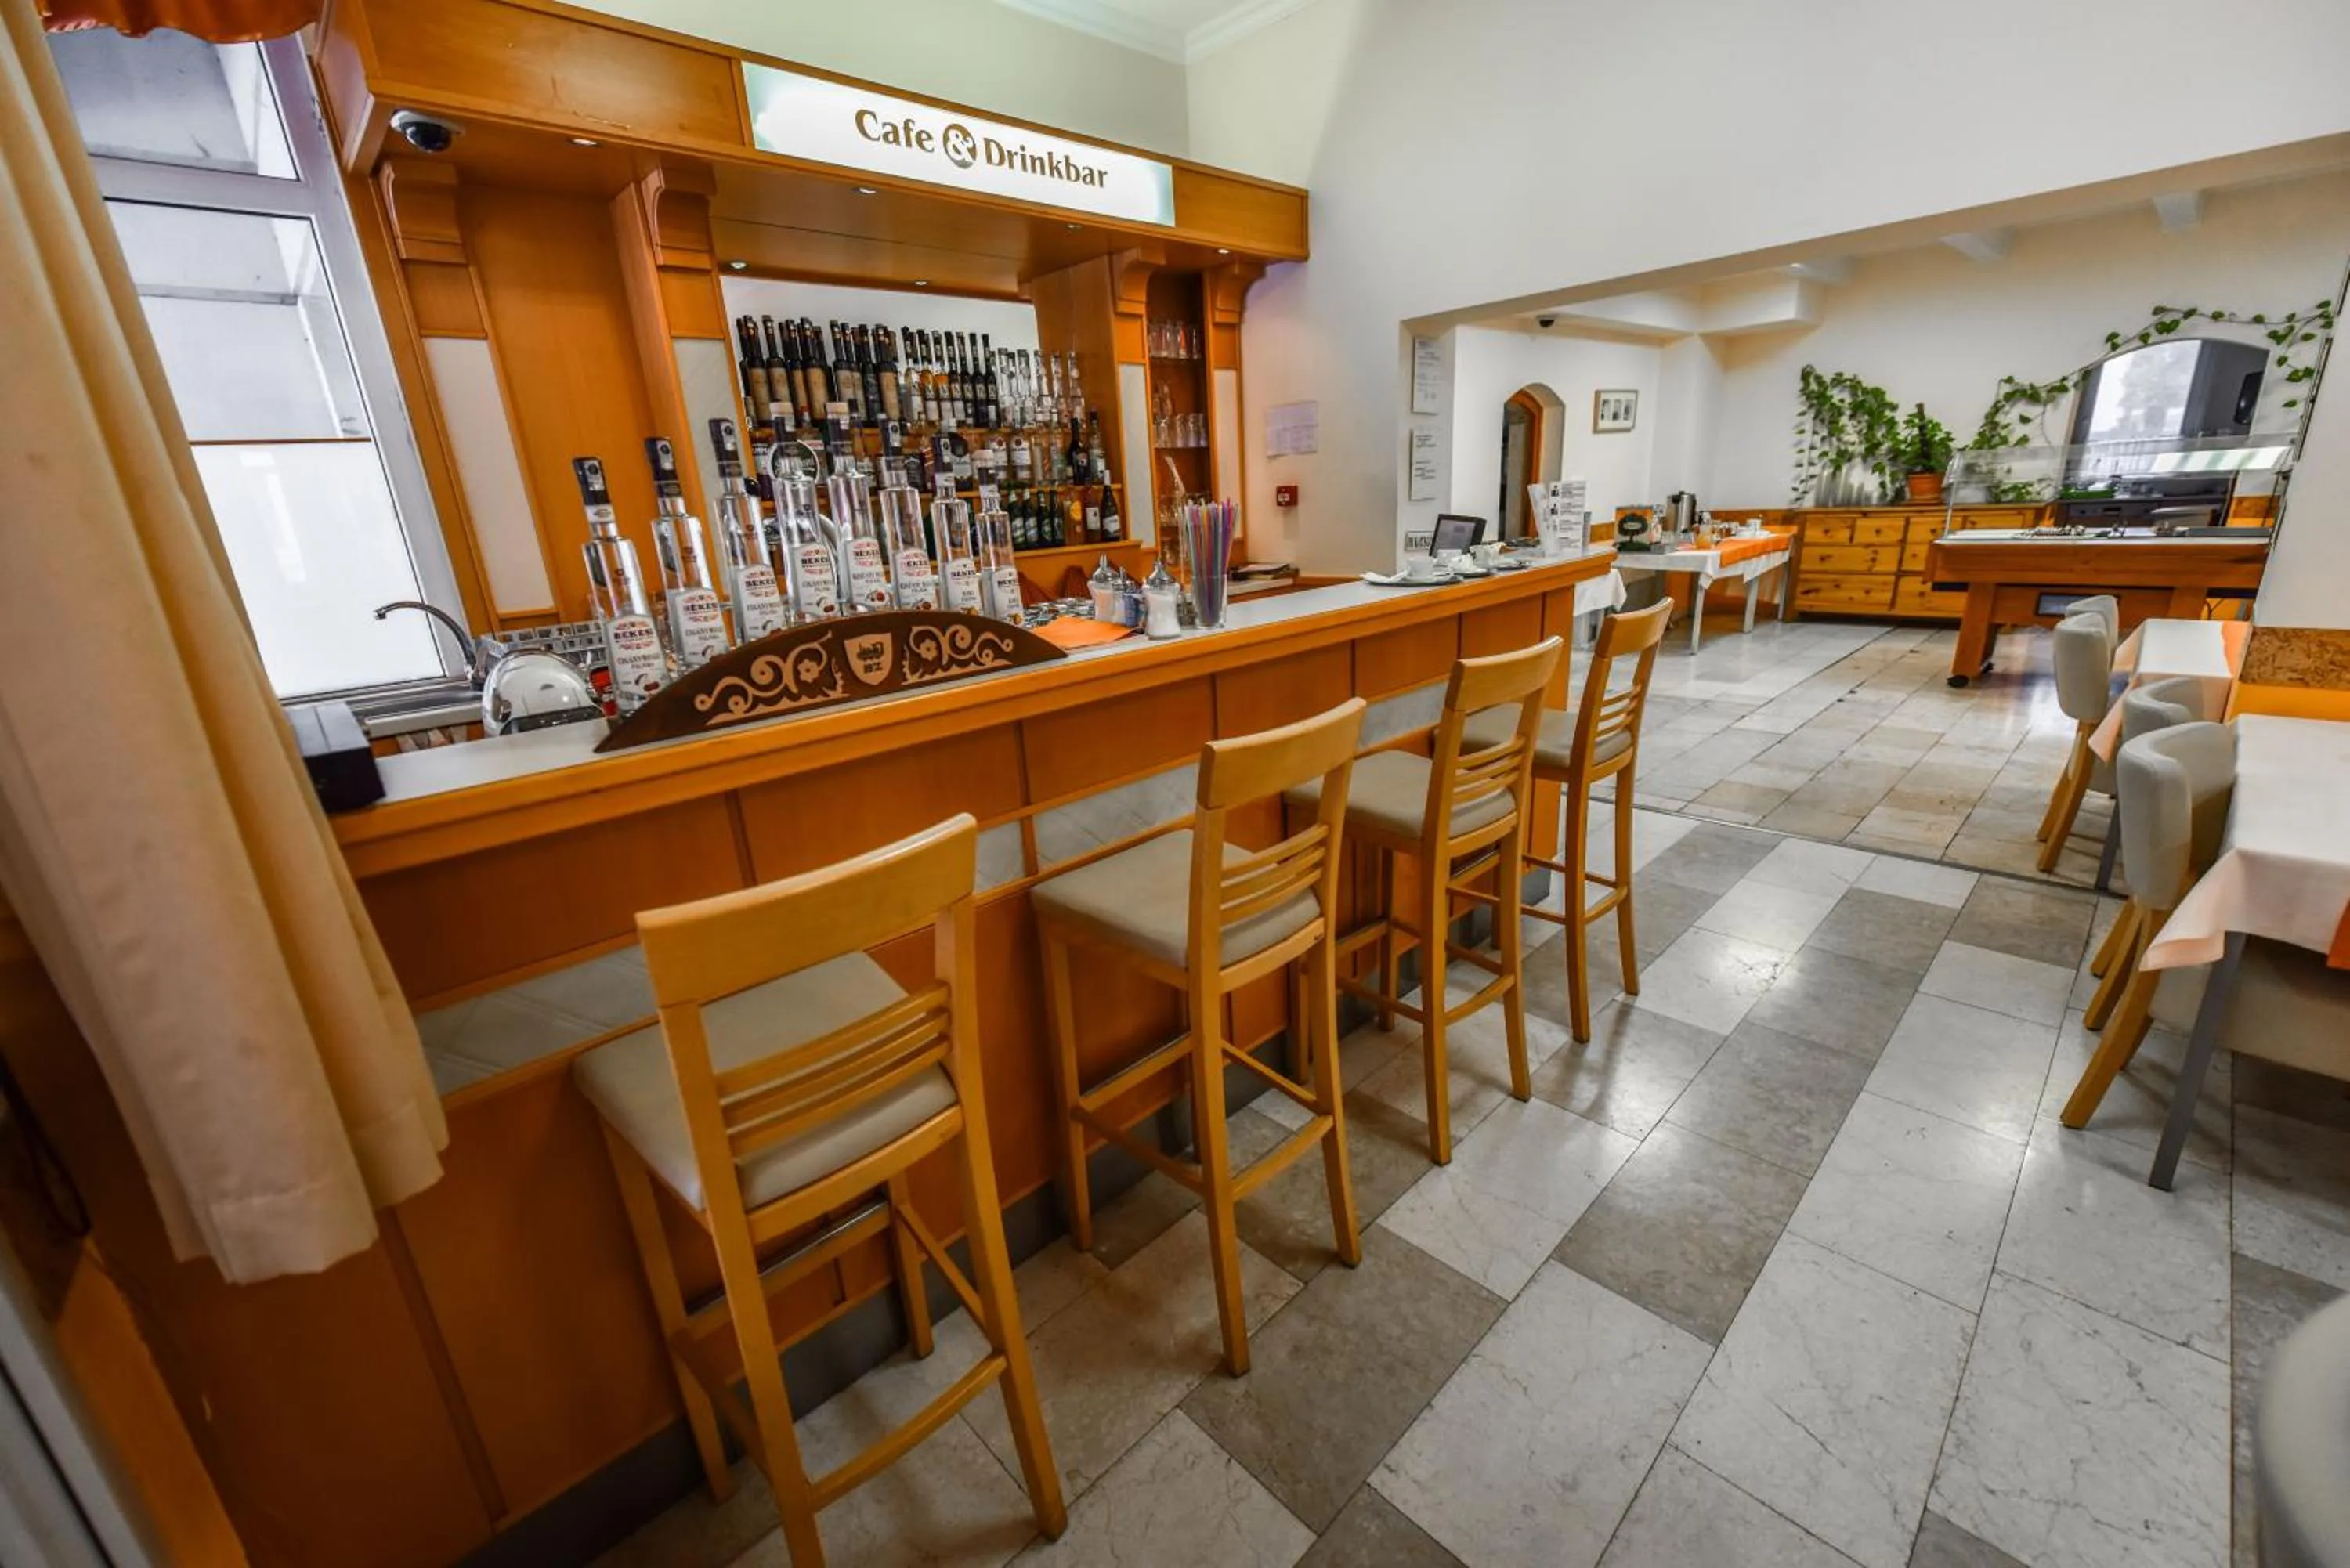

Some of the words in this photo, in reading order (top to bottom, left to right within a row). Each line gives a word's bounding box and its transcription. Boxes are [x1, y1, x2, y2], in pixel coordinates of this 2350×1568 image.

[855, 108, 935, 154] Cafe
[942, 123, 978, 169] &
[983, 137, 1108, 188] Drinkbar
